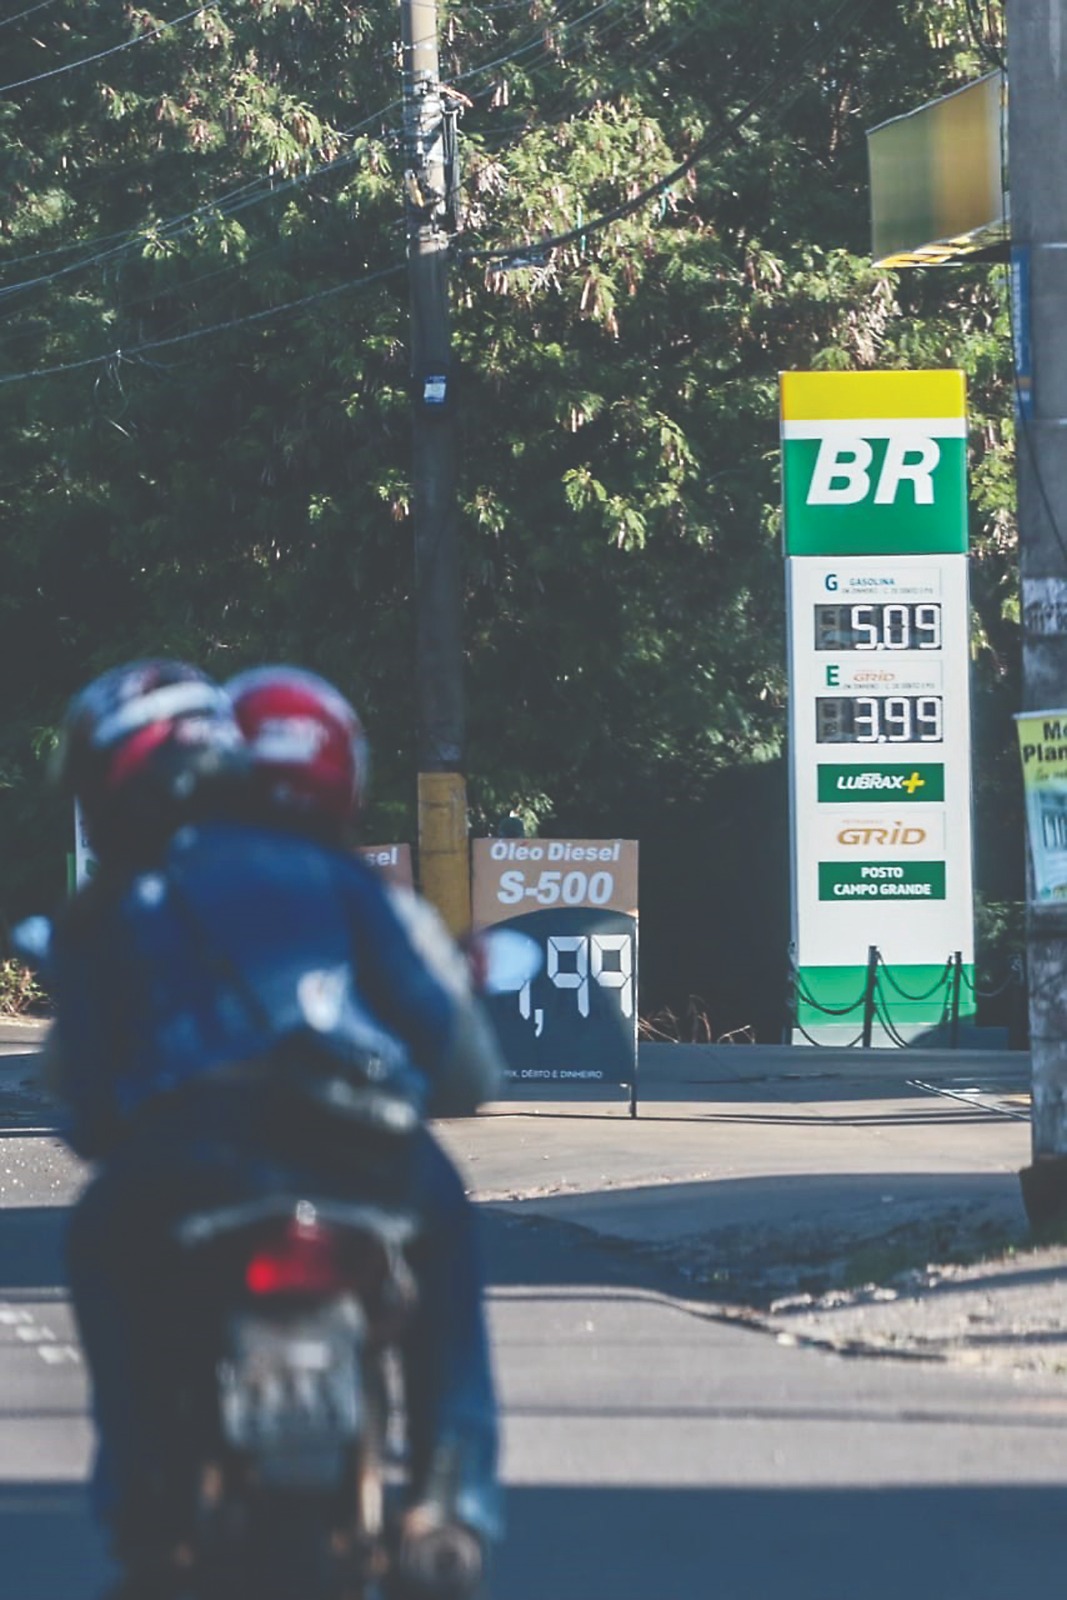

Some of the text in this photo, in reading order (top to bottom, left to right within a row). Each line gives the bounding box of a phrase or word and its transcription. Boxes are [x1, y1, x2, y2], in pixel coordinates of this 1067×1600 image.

[806, 438, 940, 505] BR
[825, 574, 838, 591] G
[849, 578, 895, 586] GASOLINA
[826, 665, 840, 686] E
[365, 847, 397, 867] sel
[547, 842, 620, 861] Diesel
[861, 867, 904, 878] POSTO
[497, 870, 614, 905] S-500
[833, 883, 931, 895] CAMPO GRANDE
[502, 934, 633, 1037] ,99
